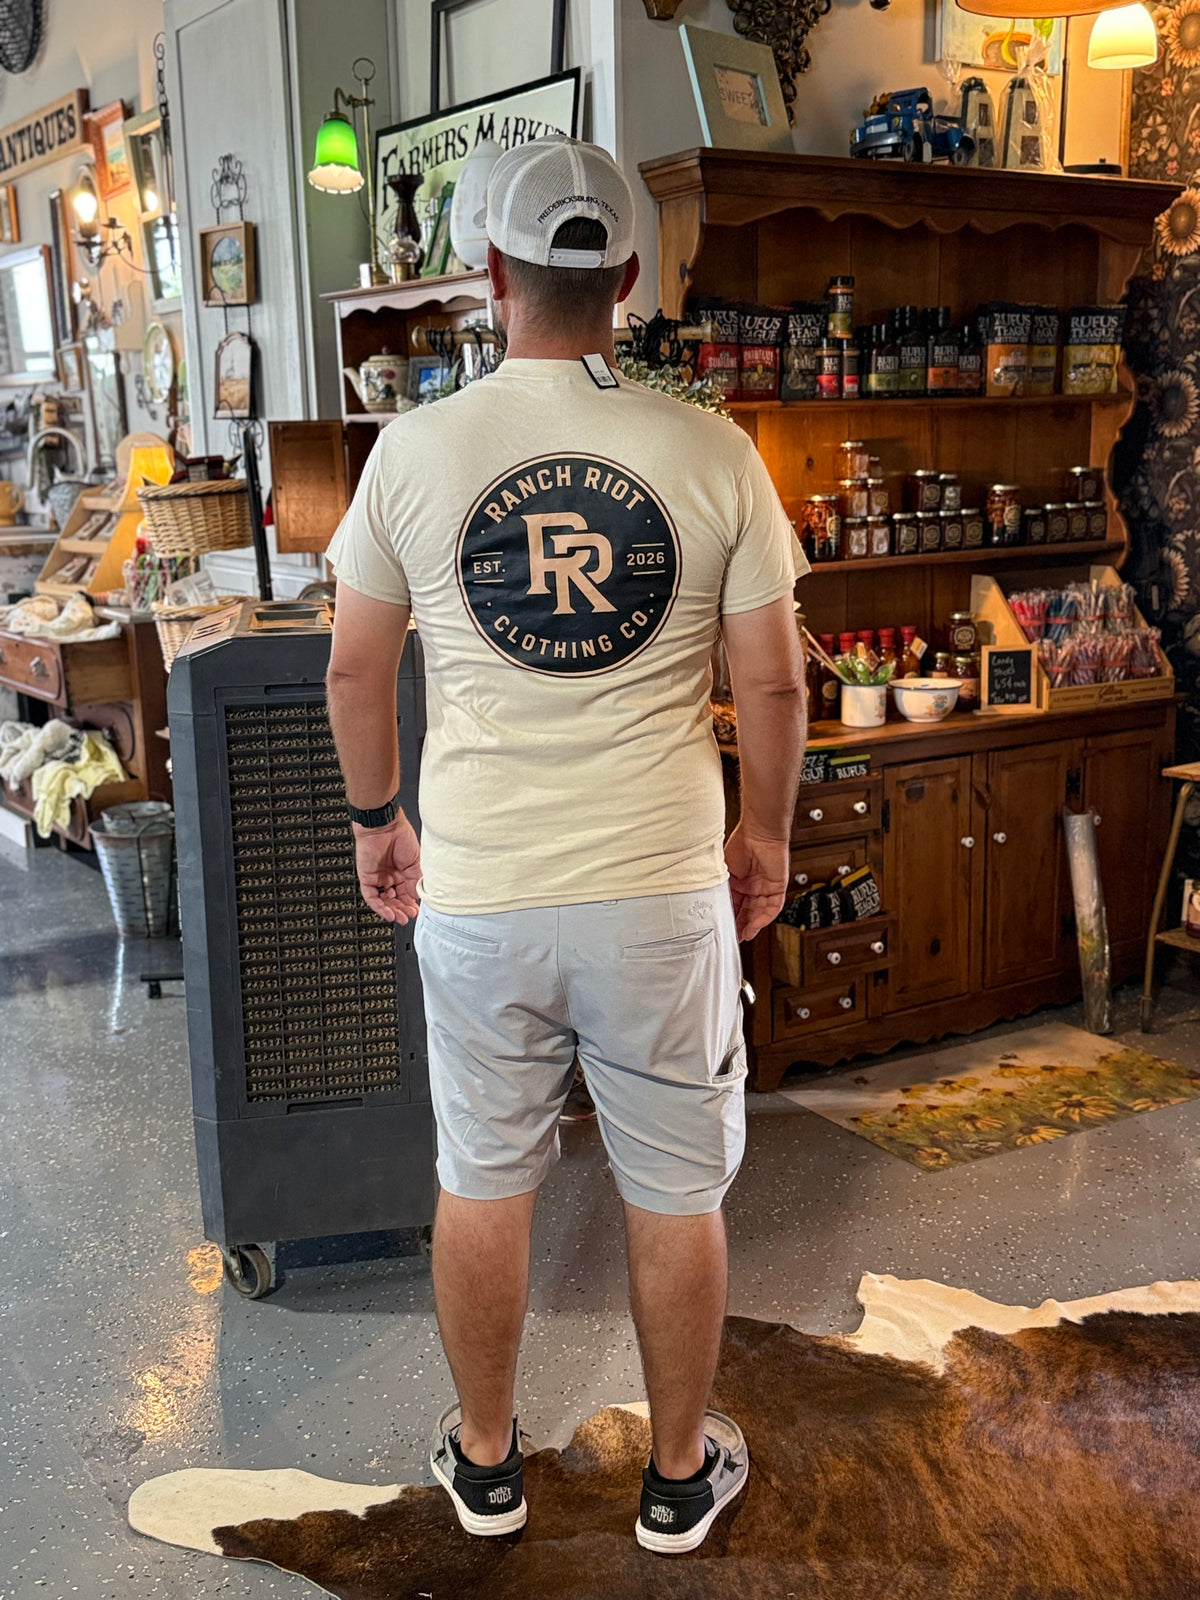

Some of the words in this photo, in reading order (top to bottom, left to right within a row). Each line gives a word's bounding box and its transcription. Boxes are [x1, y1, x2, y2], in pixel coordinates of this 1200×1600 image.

[993, 312, 1032, 327] RUFUS
[1070, 315, 1119, 329] RUFUS
[484, 465, 572, 524] RANCH
[583, 466, 646, 511] RIOT
[473, 560, 506, 574] EST.
[626, 552, 665, 566] 2026
[493, 614, 613, 659] CLOTHING
[619, 607, 654, 640] CO.
[836, 764, 867, 780] RUFUS
[488, 1487, 513, 1504] DUDE
[650, 1505, 675, 1523] DUDE
